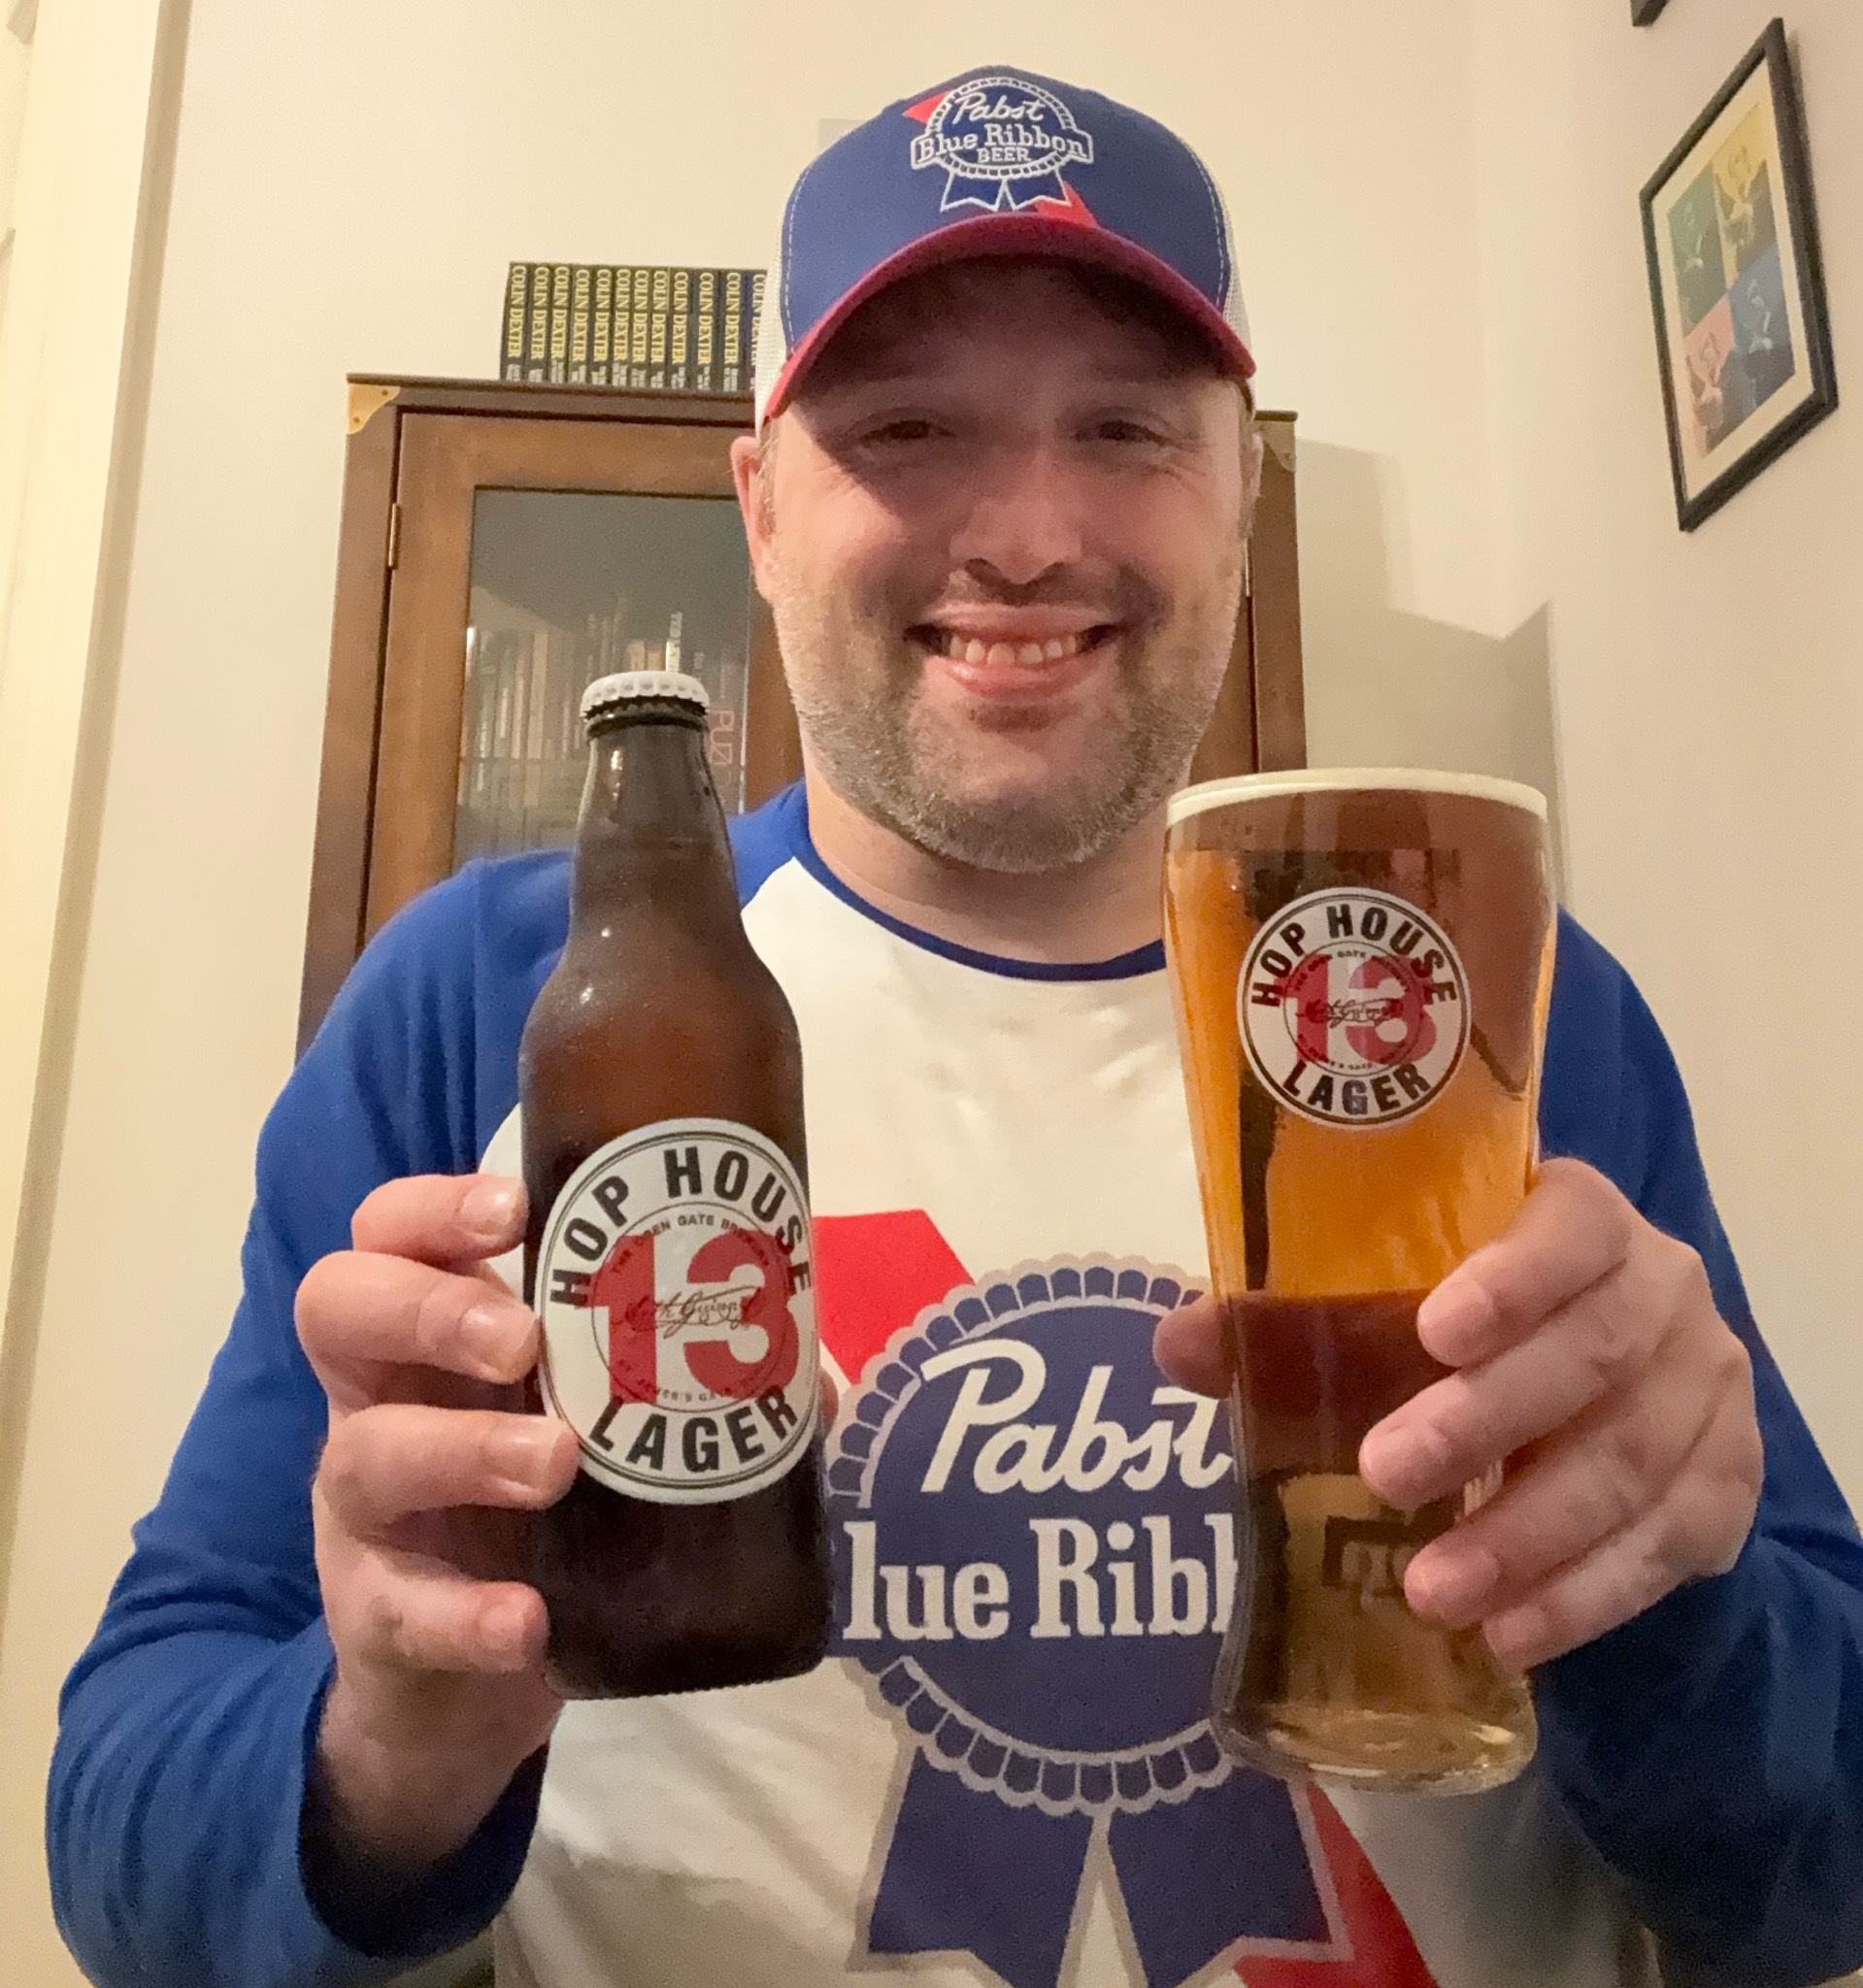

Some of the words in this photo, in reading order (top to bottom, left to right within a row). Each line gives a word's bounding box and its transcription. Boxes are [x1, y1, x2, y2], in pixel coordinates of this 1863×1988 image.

[952, 92, 1047, 124] Pabst
[917, 132, 979, 162] Blue
[984, 123, 1087, 158] Ribbon
[977, 148, 1032, 163] BEER
[510, 265, 527, 305] COLIN
[534, 266, 549, 307] COLIN
[553, 266, 569, 307] COLIN
[575, 269, 590, 310] COLIN
[596, 269, 612, 309] COLIN
[615, 268, 631, 309] COLIN
[634, 270, 649, 310] COLIN
[652, 270, 667, 311] COLIN
[673, 272, 688, 311] COLIN
[699, 273, 715, 312] COLIN
[725, 273, 741, 312] COLIN
[507, 308, 523, 358] DEXTER
[531, 310, 547, 360] DEXTER
[550, 309, 567, 359] DEXTER
[573, 313, 588, 362] DEXTER
[593, 312, 610, 362] DEXTER
[614, 312, 629, 362] DEXTER
[632, 313, 648, 363] DEXTER
[650, 314, 666, 364] DEXTER
[672, 315, 687, 365] DEXTER
[698, 315, 714, 365] DEXTER
[724, 315, 740, 365] DEXTER
[1250, 922, 1306, 1008] HOP
[1326, 904, 1457, 1006] HOUSE
[1273, 953, 1437, 1065] 13
[1282, 1060, 1431, 1115] LAGER
[549, 1176, 630, 1307] HOP
[663, 1146, 812, 1297] HOUSE
[678, 1214, 715, 1227] GATE
[575, 1229, 800, 1404] 13
[588, 1385, 798, 1472] LAGER
[919, 1339, 1233, 1493] Pabst
[842, 1520, 1010, 1640] lue
[1029, 1513, 1238, 1639] Rib
